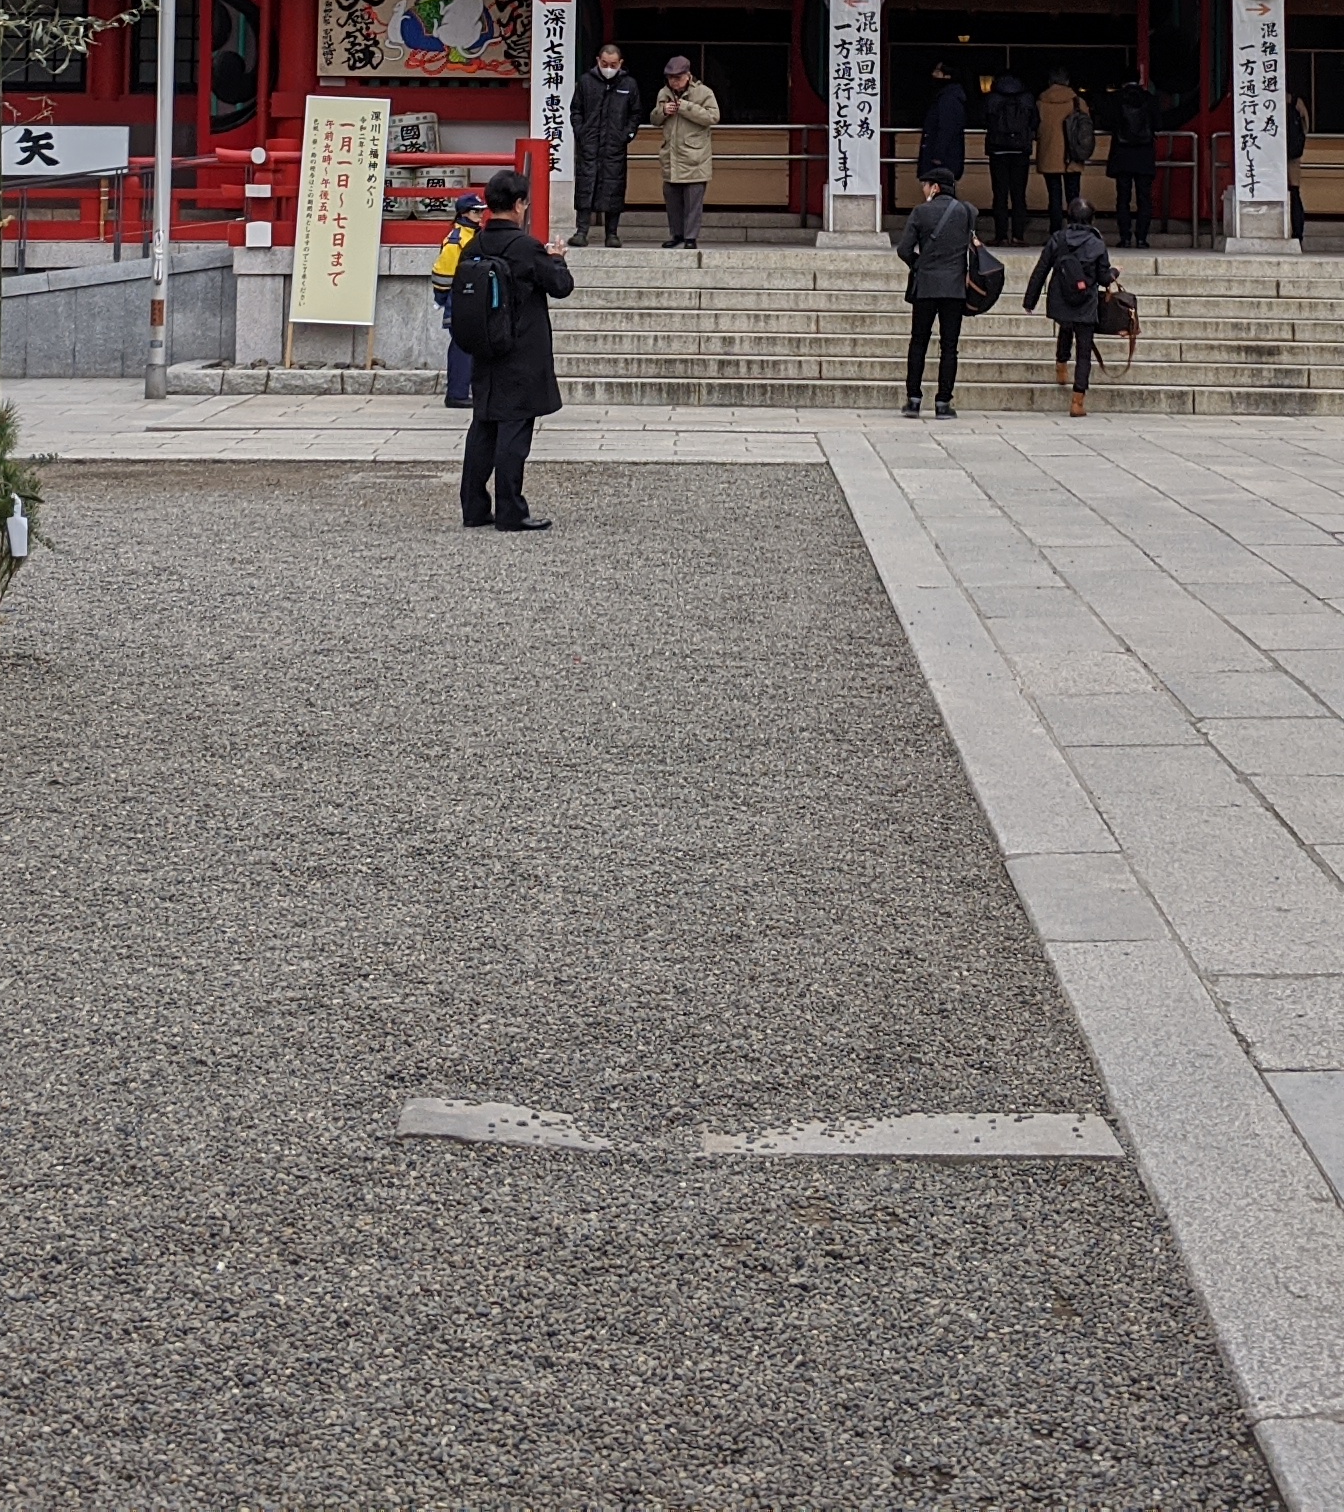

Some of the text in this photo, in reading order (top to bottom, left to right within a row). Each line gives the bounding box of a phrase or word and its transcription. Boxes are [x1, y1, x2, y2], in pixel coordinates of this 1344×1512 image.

[542, 8, 566, 91] 深川七福神
[14, 128, 60, 166] 矢
[832, 23, 855, 192] 一方通行と致します
[1238, 43, 1261, 199] 一方通行と致します
[365, 110, 382, 209] 深川七福神めぐり
